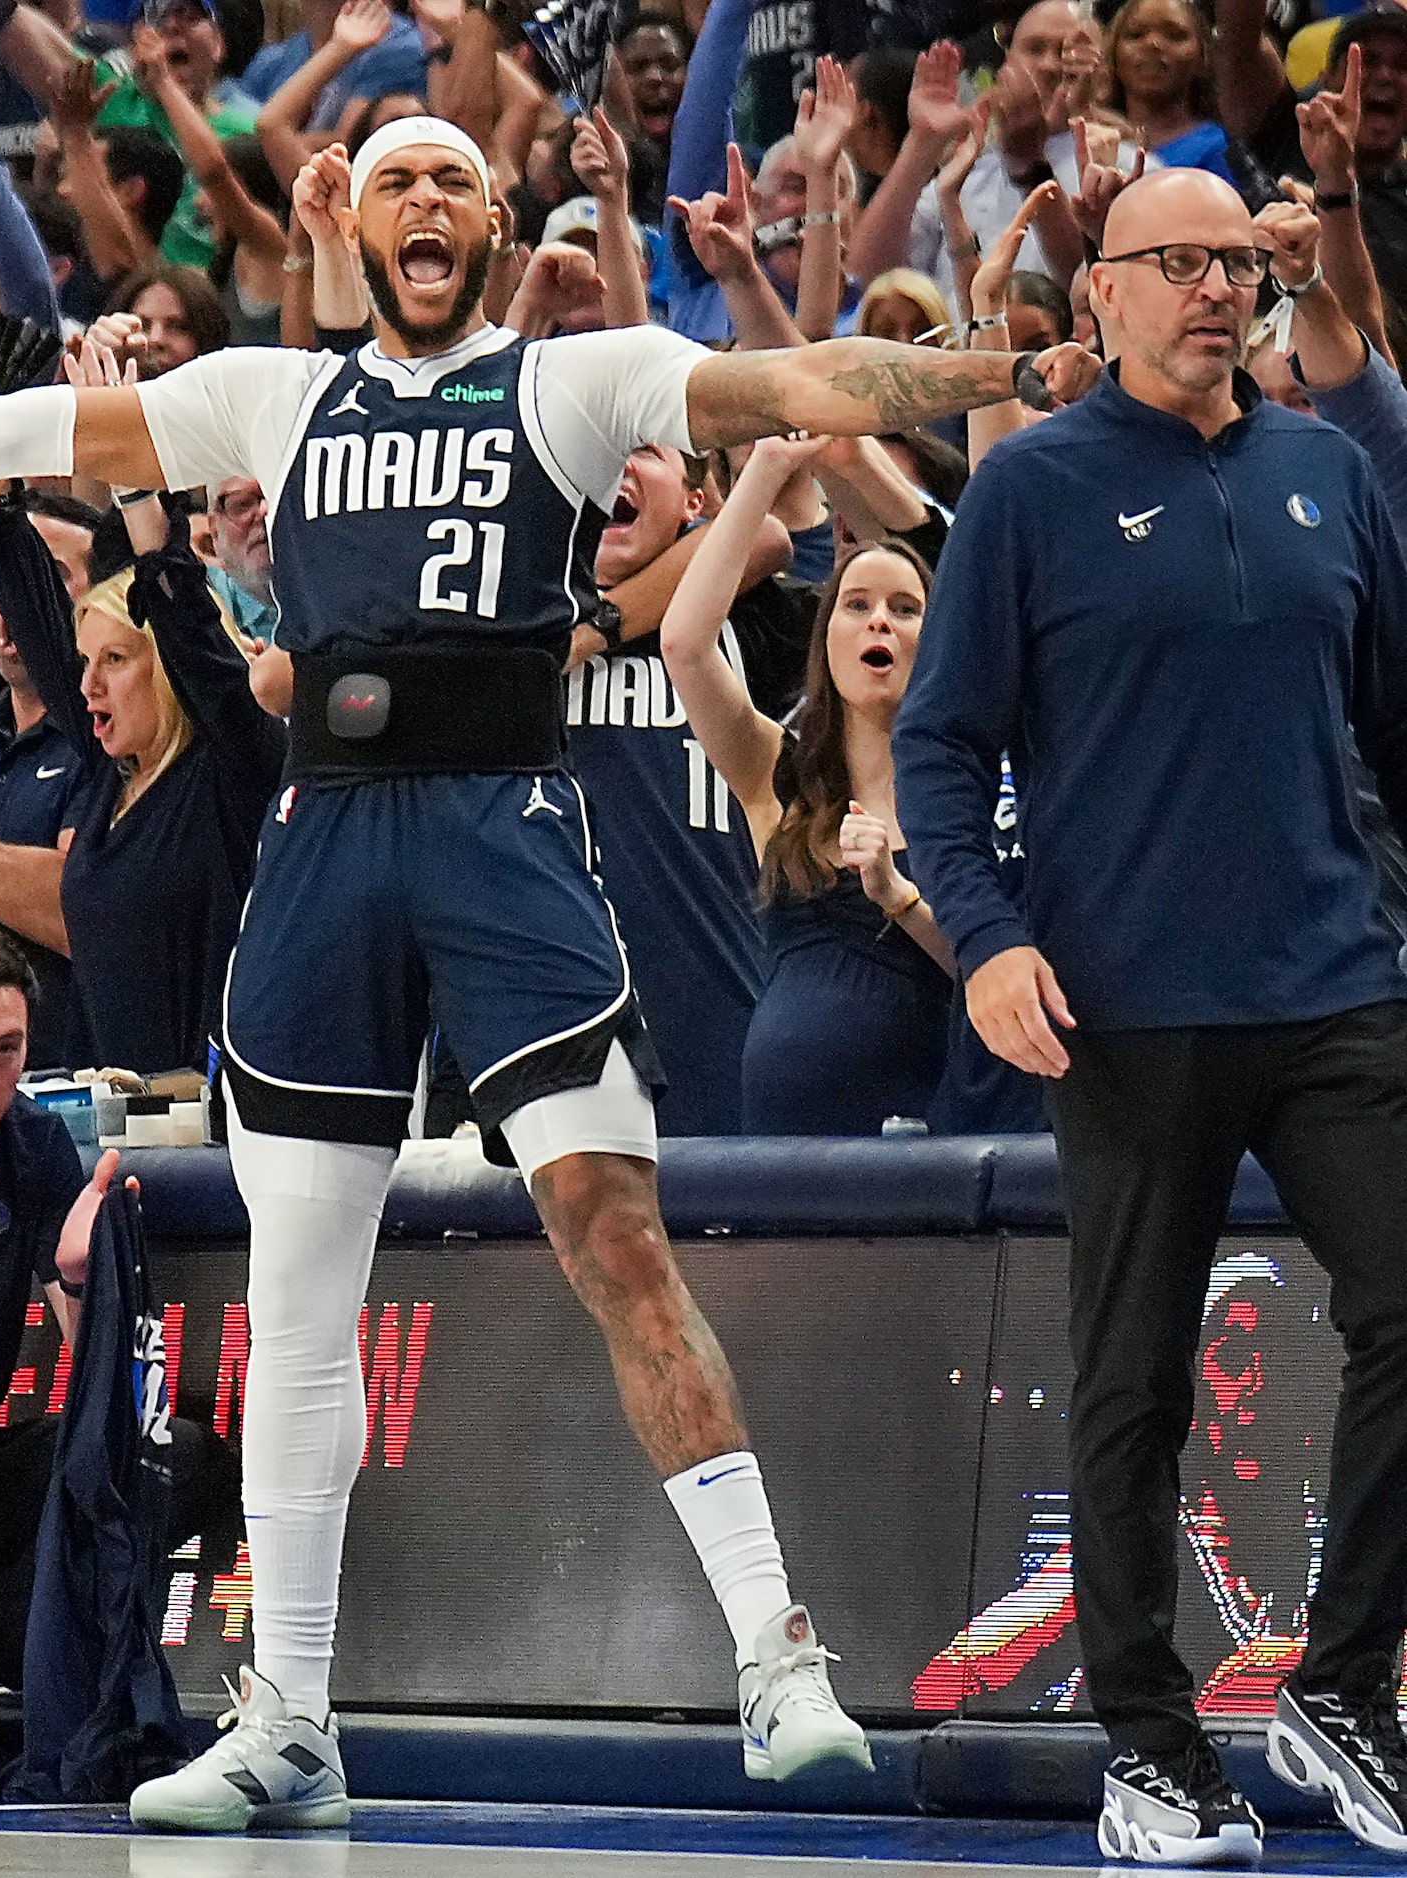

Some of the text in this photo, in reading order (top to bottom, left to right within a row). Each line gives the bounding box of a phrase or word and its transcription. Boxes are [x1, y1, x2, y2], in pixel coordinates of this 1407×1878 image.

[441, 384, 505, 404] chime
[304, 427, 514, 521] MAVS
[419, 517, 505, 619] 21
